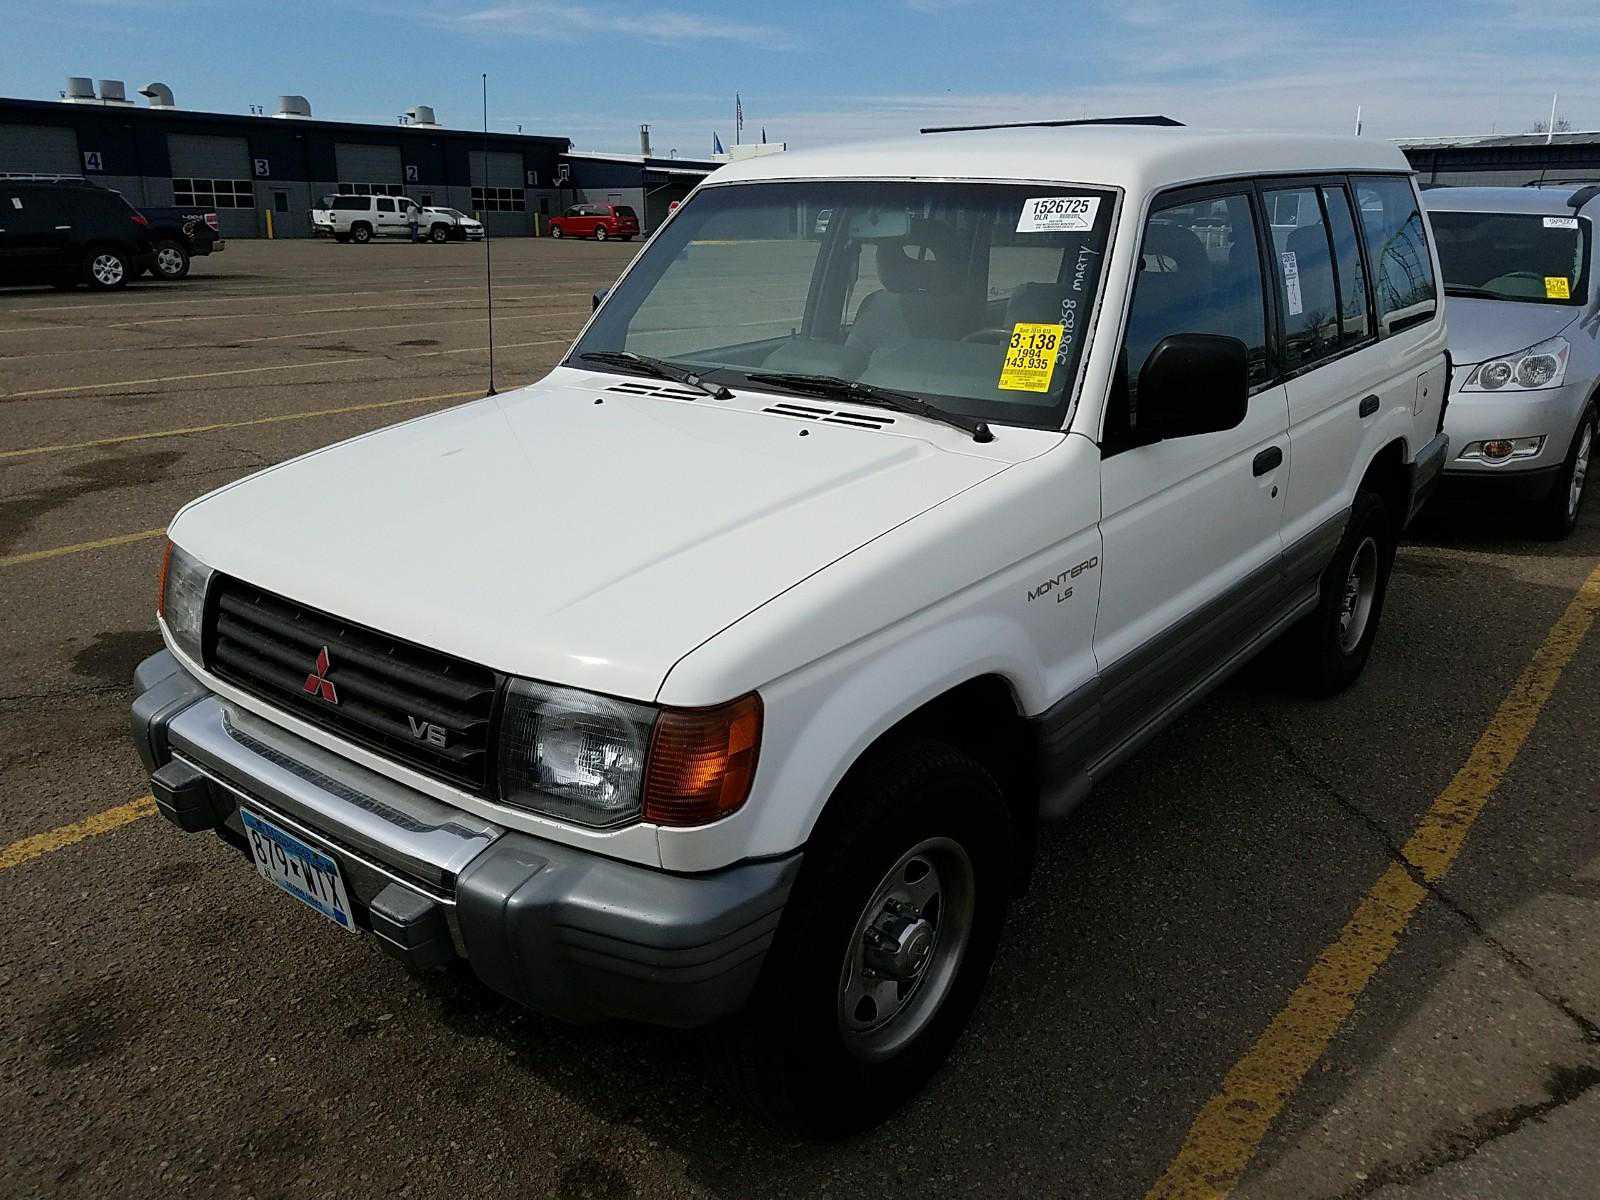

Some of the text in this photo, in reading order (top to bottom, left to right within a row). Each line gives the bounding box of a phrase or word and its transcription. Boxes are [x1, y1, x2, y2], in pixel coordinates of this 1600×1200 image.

[87, 153, 101, 169] 4
[256, 160, 267, 175] 3
[408, 167, 417, 180] 2
[1033, 199, 1090, 214] 1526725
[1072, 246, 1100, 291] MARTY
[1010, 333, 1057, 350] 3:138
[1017, 348, 1042, 358] 1994
[1027, 556, 1098, 602] MONTERO
[1057, 586, 1073, 603] LS
[407, 715, 446, 747] V6
[251, 829, 289, 877] 879
[299, 856, 345, 912] WTX
